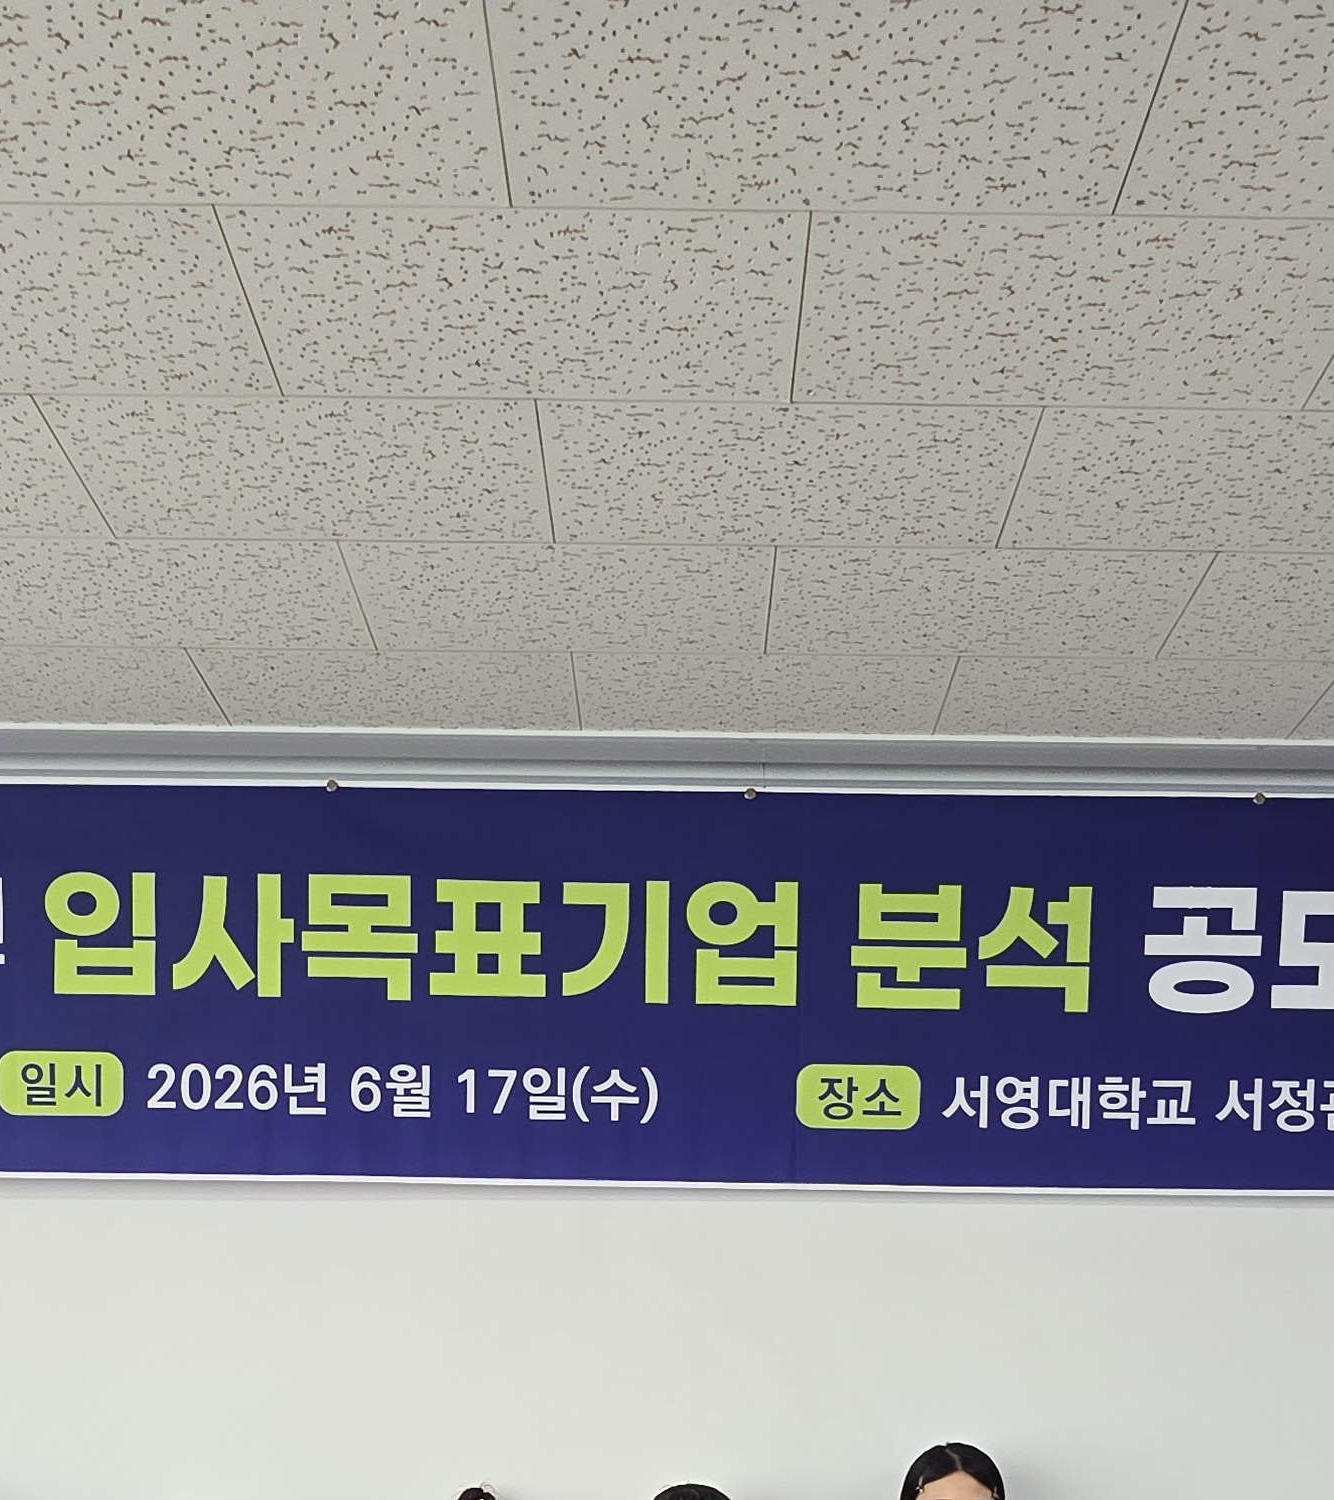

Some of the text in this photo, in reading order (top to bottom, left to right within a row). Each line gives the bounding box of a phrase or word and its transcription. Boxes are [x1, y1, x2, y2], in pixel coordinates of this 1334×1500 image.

[44, 871, 800, 1007] 입사목표기업
[851, 883, 1091, 1013] 분석
[19, 1060, 105, 1110] 일시
[147, 1062, 658, 1125] 2026년 6월 17일(수)
[817, 1074, 902, 1121] 장소
[941, 1077, 1196, 1132] 서영대학교
